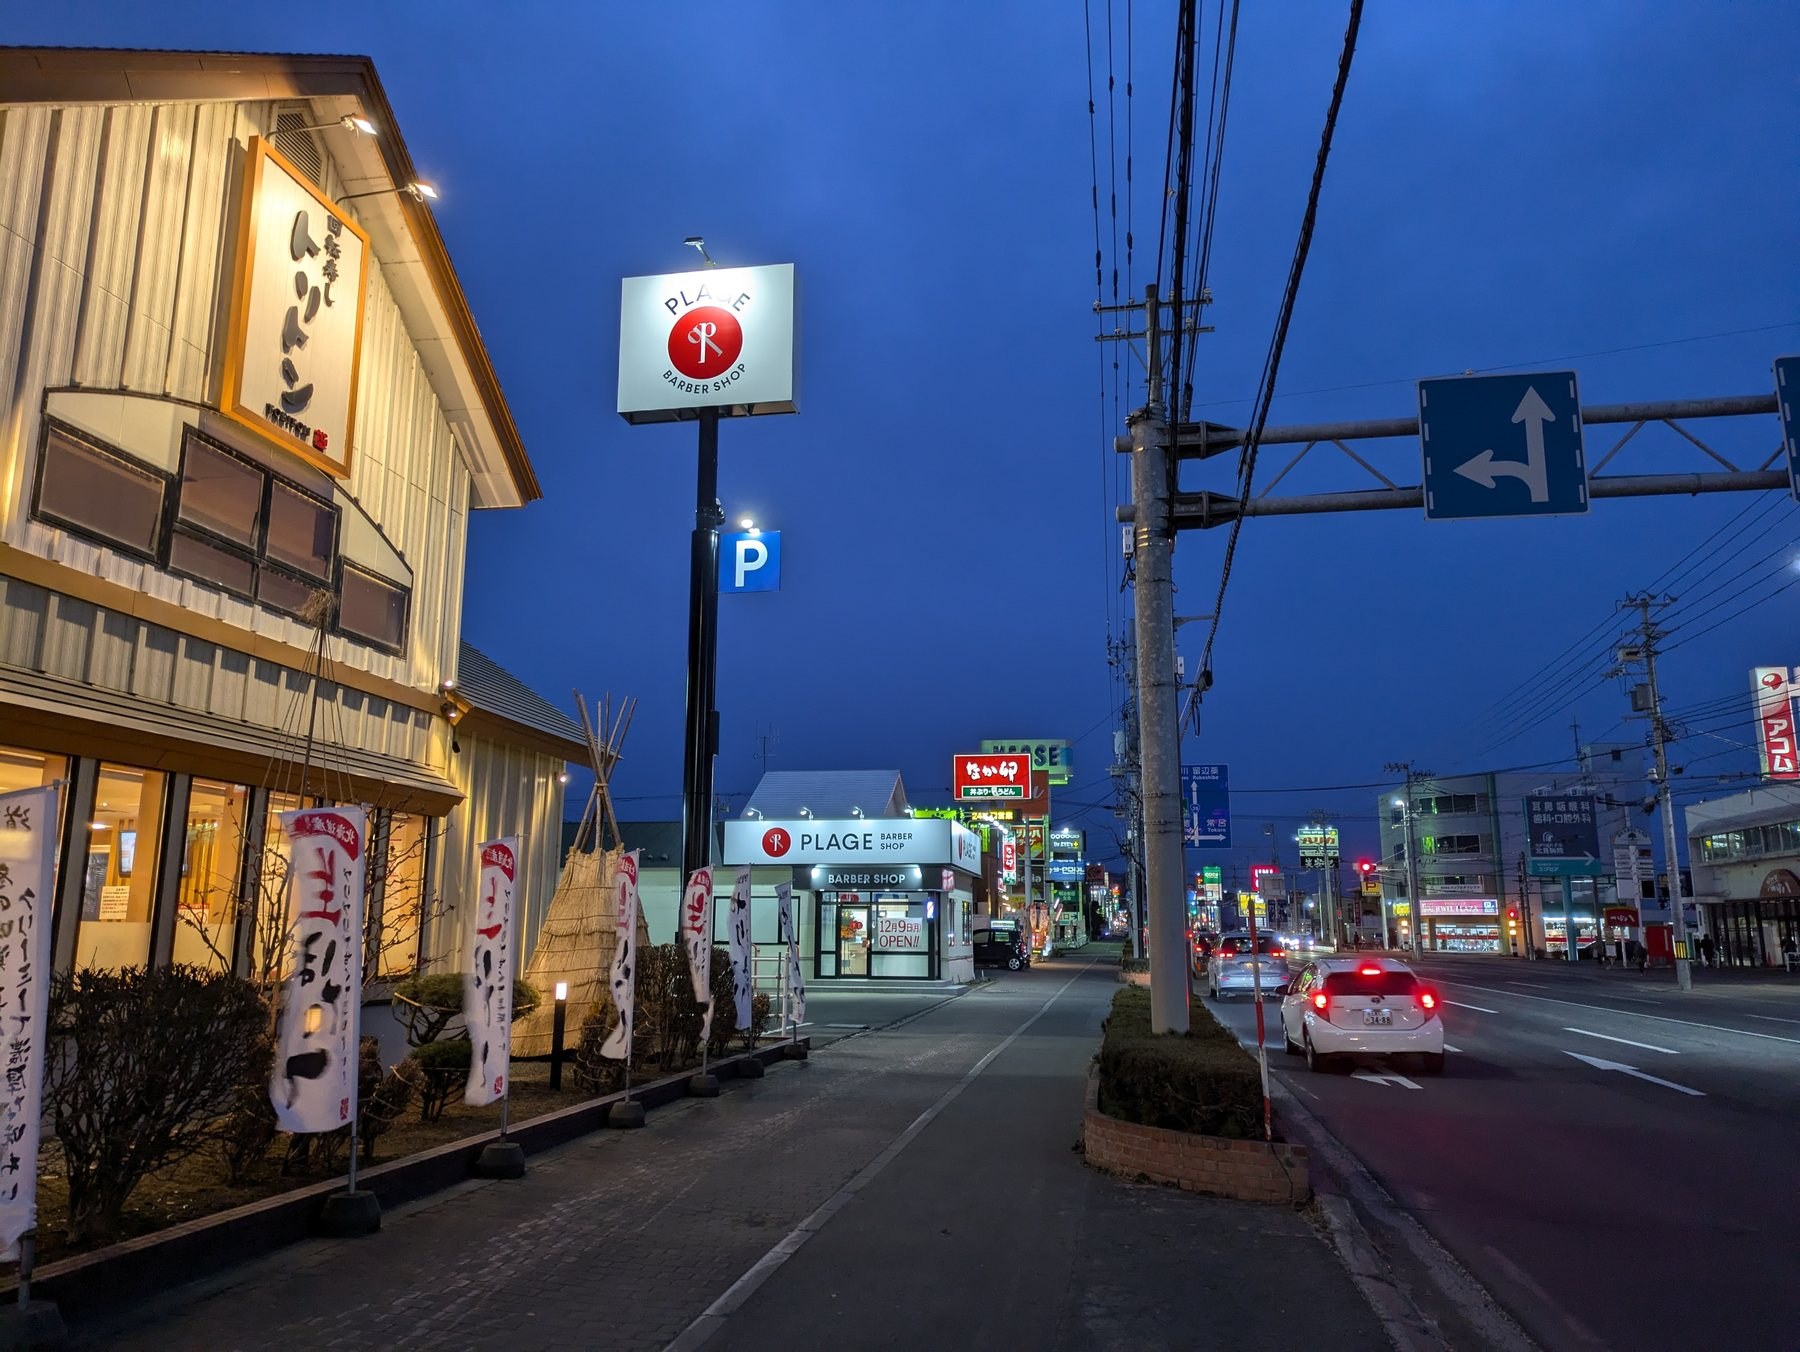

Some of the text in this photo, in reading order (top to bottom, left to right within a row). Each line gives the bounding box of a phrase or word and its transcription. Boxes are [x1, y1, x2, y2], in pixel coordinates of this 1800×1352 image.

[322, 215, 343, 308] 回転寿し
[280, 210, 321, 414] トリトン
[663, 363, 746, 394] BARBER SHOP
[735, 540, 768, 588] P
[1767, 719, 1793, 772] アコム
[966, 761, 1018, 783] なか卯
[800, 832, 913, 851] PLAGE BARBER
[880, 842, 905, 850] SHOP
[828, 874, 906, 884] BARBER SHOP
[1016, 874, 1041, 883] Seia
[1365, 882, 1376, 891] P
[880, 935, 920, 948] OPEN!!
